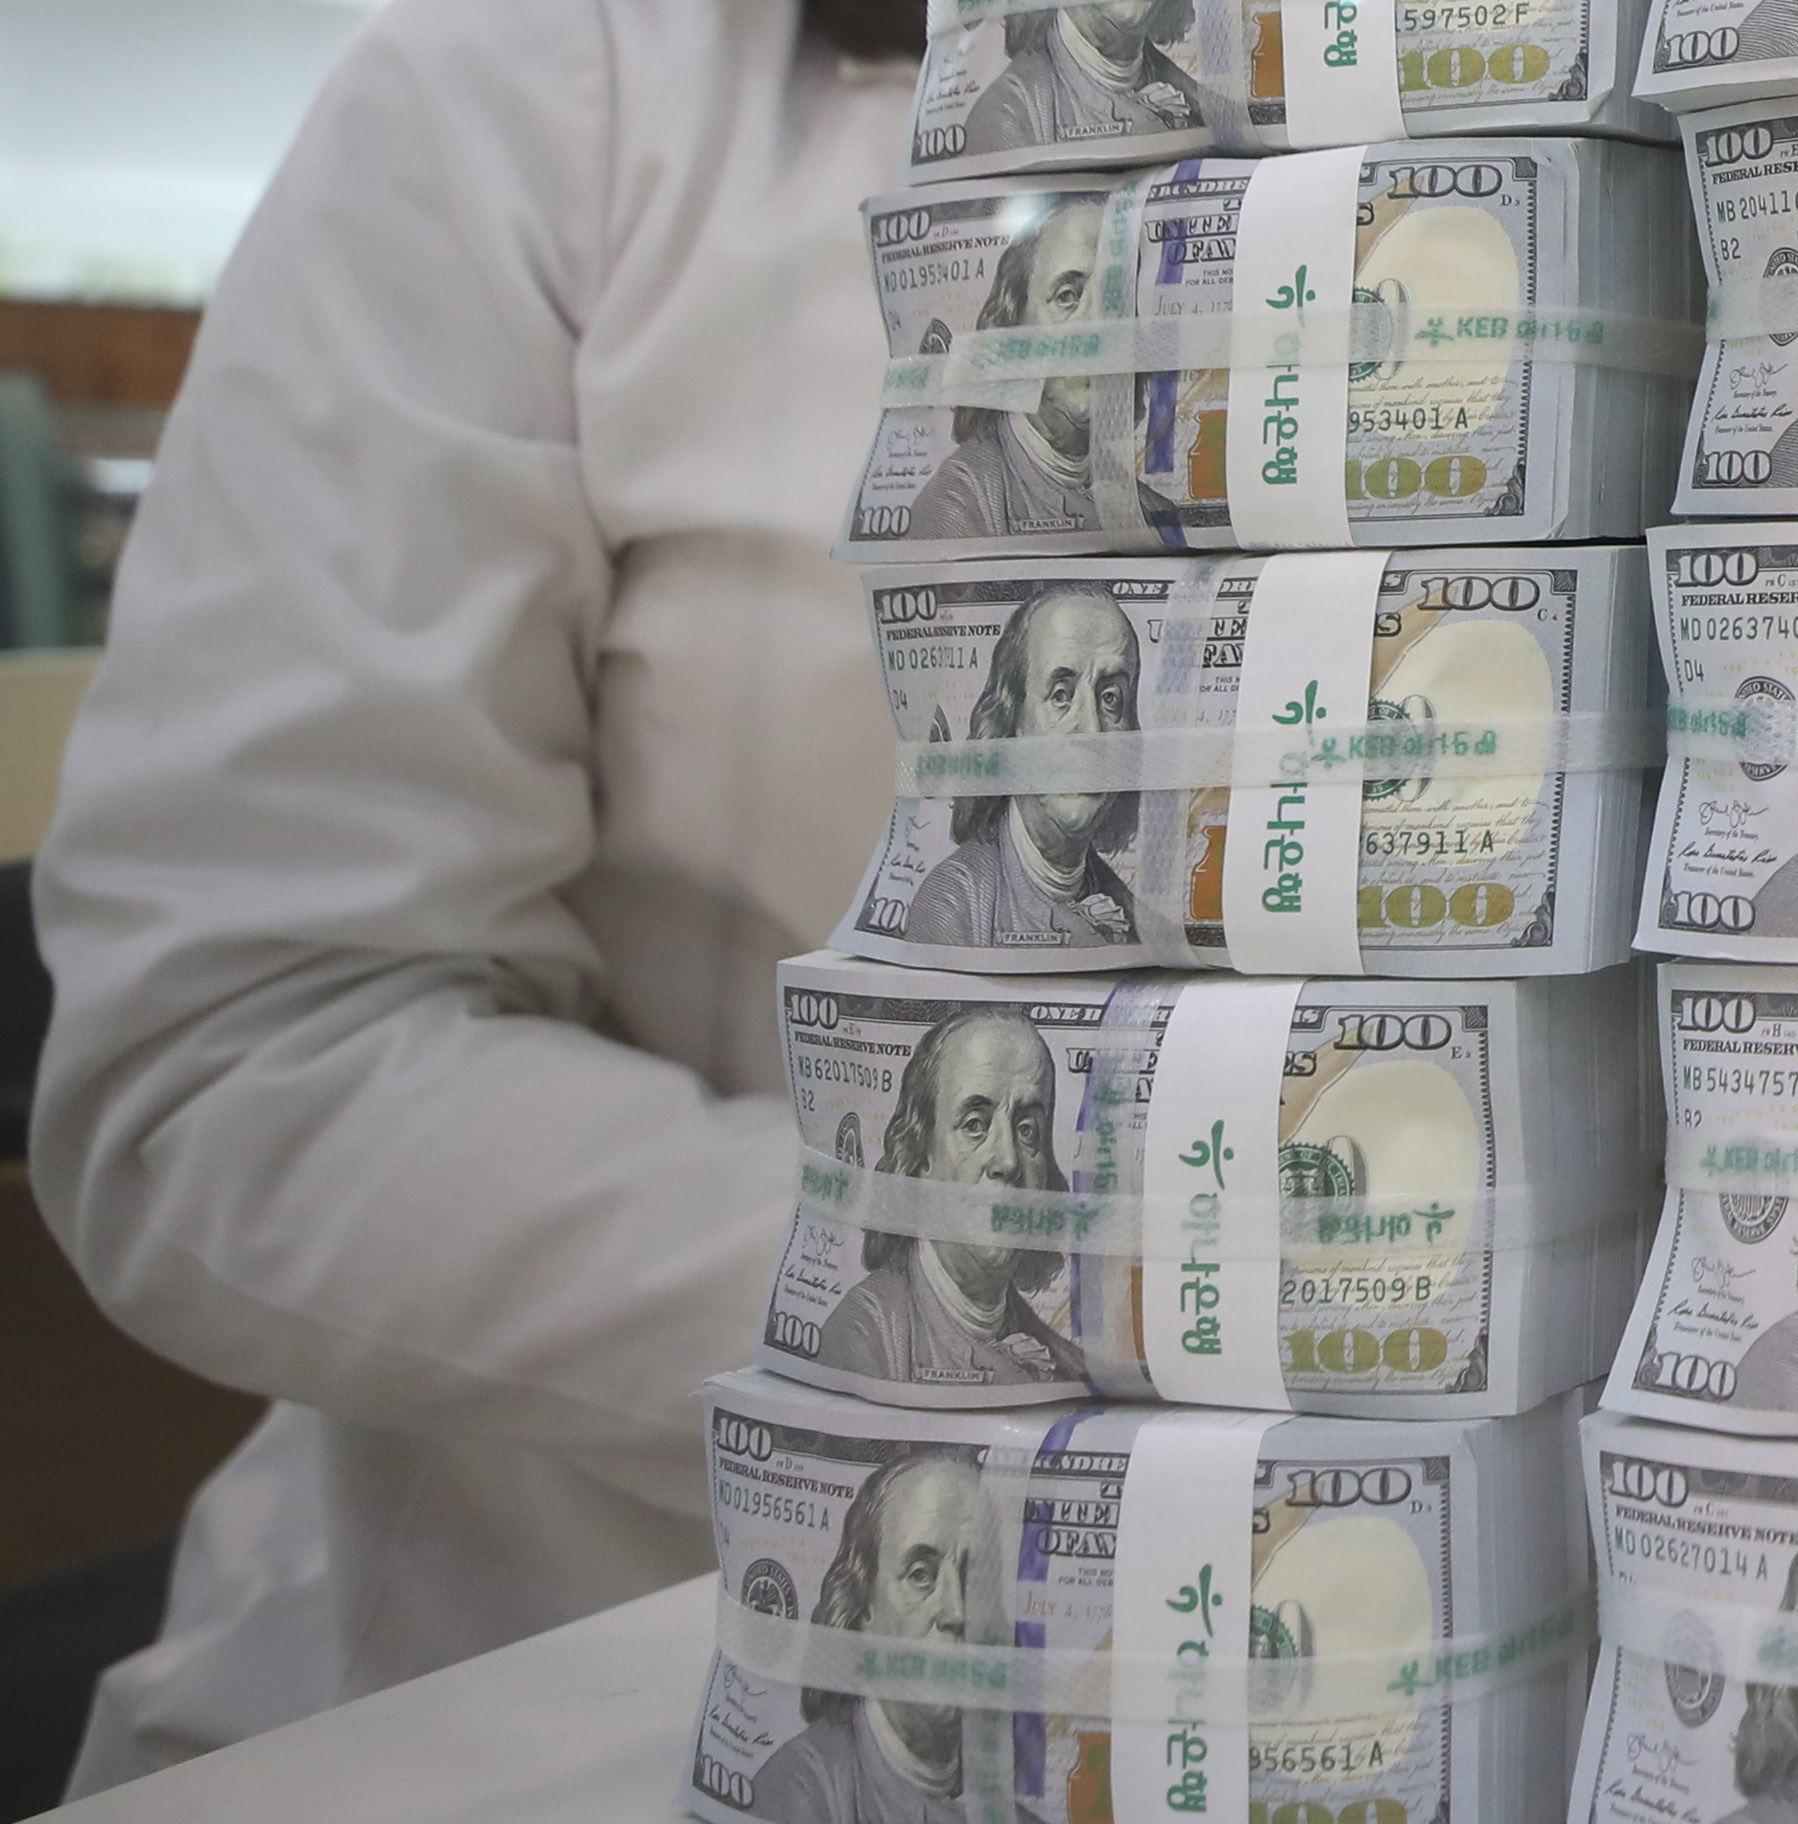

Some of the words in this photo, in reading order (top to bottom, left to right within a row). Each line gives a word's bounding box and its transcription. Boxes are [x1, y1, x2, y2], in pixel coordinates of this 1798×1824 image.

[1666, 27, 1739, 64] 100
[918, 125, 966, 158] 100
[1069, 123, 1120, 136] FRANKLIN
[1704, 126, 1774, 167] 100
[1389, 165, 1502, 199] 100
[1712, 165, 1763, 185] FEDERAL
[875, 210, 931, 247] 100
[881, 245, 921, 263] FEDERAL
[922, 239, 973, 256] RESERVE
[974, 234, 1010, 249] NOTE
[1721, 238, 1741, 261] B2
[1155, 295, 1189, 316] JULY
[1456, 317, 1508, 340] KEB
[1702, 450, 1772, 483] 100
[861, 506, 911, 535] 100
[1022, 519, 1074, 529] FRANKLIN
[1675, 553, 1759, 587] 100
[880, 591, 938, 623] 100
[1417, 577, 1540, 610] 100
[1681, 591, 1745, 605] FEDERAL
[886, 628, 931, 642] FEDERAL
[968, 624, 1001, 636] NOTE
[1681, 617, 1701, 642] MD
[1358, 884, 1514, 928] 100
[1672, 892, 1755, 930] 100
[1004, 933, 1059, 943] FRANKLIN
[789, 994, 839, 1029] 100
[1677, 998, 1756, 1033] 100
[795, 1031, 834, 1047] FEDERAL
[834, 1037, 877, 1052] RESERVE
[878, 1043, 911, 1056] NOTE
[1334, 1015, 1452, 1050] 100
[1683, 1040, 1742, 1053] FEDERAL
[1182, 1193, 1221, 1355] 하나은행
[1281, 1278, 1406, 1304] 2017509
[774, 1312, 821, 1357] 100
[1283, 1328, 1448, 1373] 100
[923, 1369, 979, 1380] FRANKLIN
[1657, 1353, 1736, 1399] 100
[717, 1419, 772, 1462] 100
[719, 1459, 762, 1483] FEDERAL
[762, 1470, 819, 1493] RESERVE
[820, 1483, 854, 1499] NOTE
[1286, 1467, 1412, 1507] 100
[1608, 1461, 1688, 1508] 100
[733, 1485, 815, 1527] 01956561
[1615, 1504, 1676, 1528] FEDERAL
[1677, 1516, 1752, 1540] RESERVE
[1641, 1534, 1748, 1579] 02627014
[1024, 1592, 1056, 1617] JULY
[703, 1753, 754, 1809] 100
